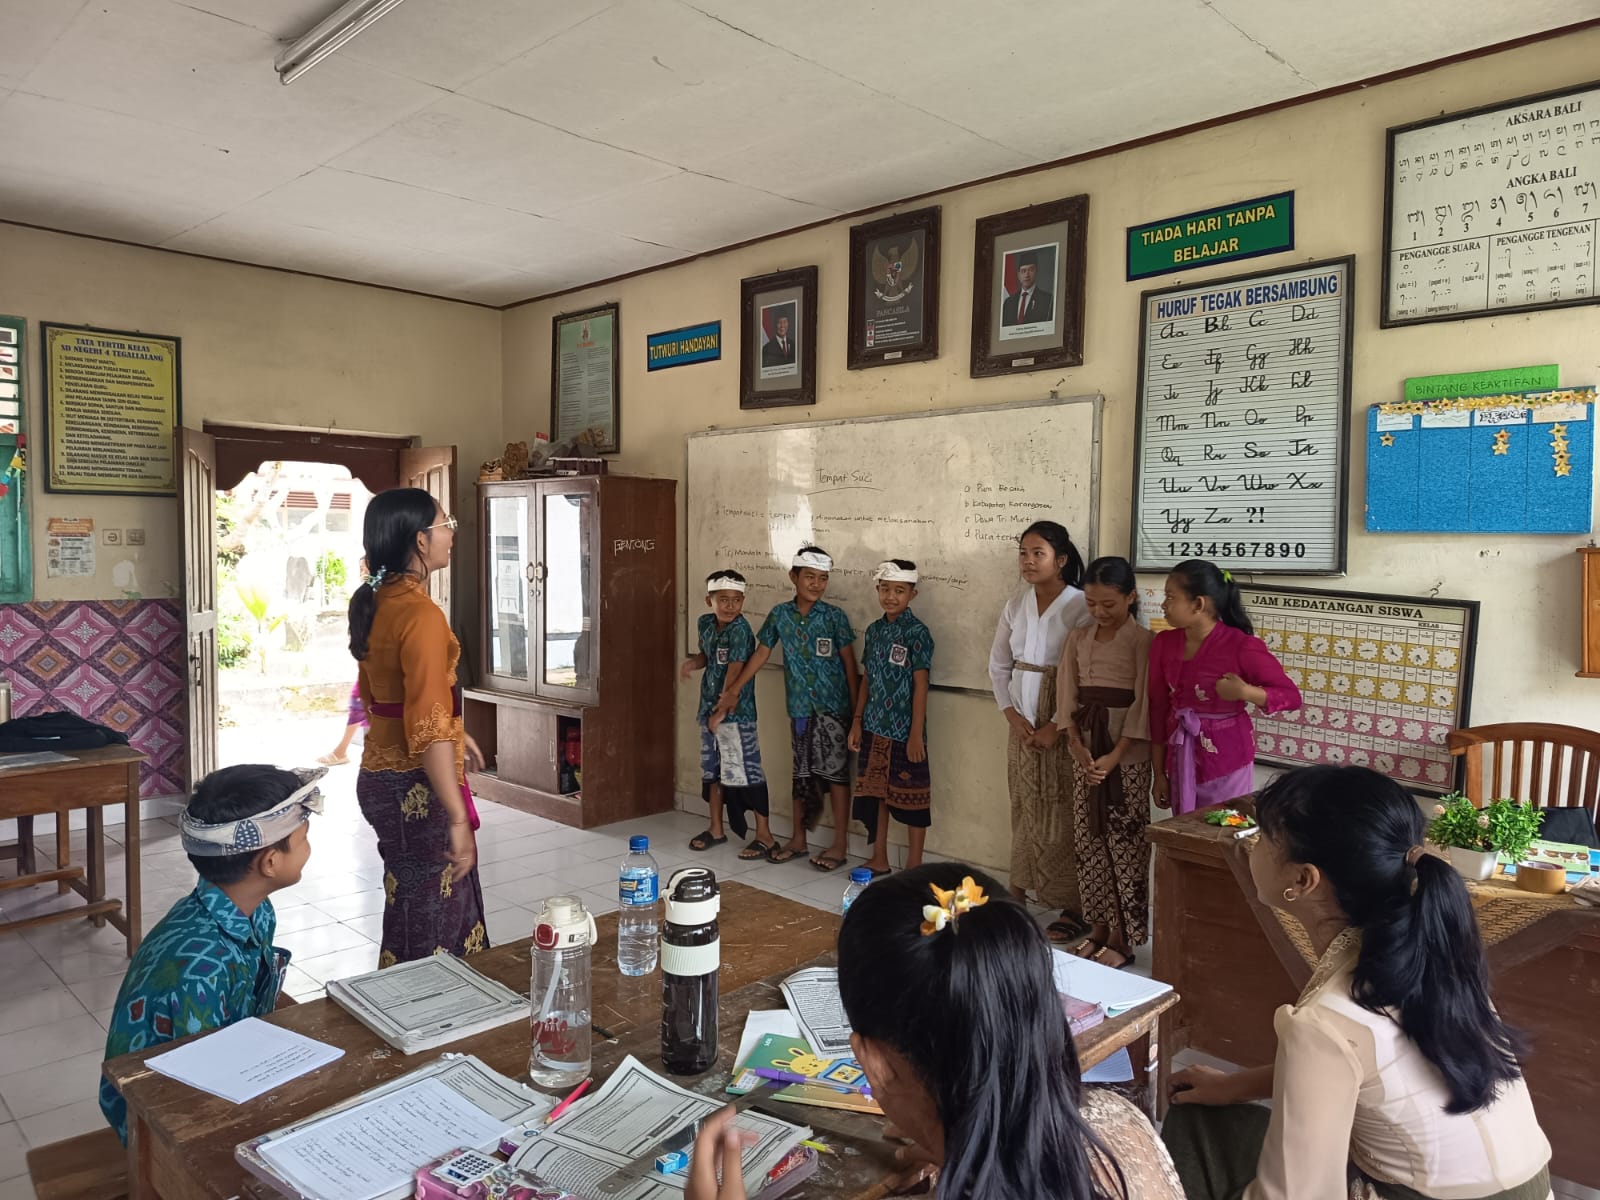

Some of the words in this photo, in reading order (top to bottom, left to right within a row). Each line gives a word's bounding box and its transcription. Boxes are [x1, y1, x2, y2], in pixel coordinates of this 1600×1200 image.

[1505, 109, 1552, 128] AKSARA
[1553, 101, 1582, 118] BALI
[1506, 170, 1547, 189] ANGKA
[1549, 166, 1577, 182] BALI
[1527, 212, 1534, 222] 5
[1553, 208, 1559, 218] 6
[1582, 203, 1588, 213] 7
[1142, 225, 1183, 246] TIADA
[1186, 215, 1222, 238] HARI
[1226, 204, 1276, 228] TANPA
[1438, 227, 1444, 237] 2
[1463, 223, 1469, 233] 3
[1495, 218, 1502, 227] 4
[1412, 231, 1417, 241] 1
[1496, 228, 1545, 246] PENGANGGE
[1546, 224, 1591, 240] TENGENAN
[1173, 237, 1239, 263] BELAJAR
[1399, 246, 1451, 261] PENGANGGE
[1451, 241, 1481, 255] SUARA
[1157, 298, 1198, 319] HURUF
[1201, 290, 1242, 313] TEGAK
[1245, 274, 1338, 306] BERSAMBUNG
[1160, 322, 1189, 339] Aa
[1204, 315, 1232, 334] Bb
[1248, 310, 1269, 328] Cc
[1291, 304, 1320, 322] Dd
[76, 338, 94, 346] TATA
[128, 344, 150, 352] KELAS
[649, 342, 679, 361] TUTWURI
[680, 333, 718, 355] HANDAYANI
[1415, 382, 1468, 395] BINTANG
[1472, 376, 1542, 392] KEAKTIFAN
[1156, 414, 1189, 431] Mm
[1200, 411, 1230, 429] Nn
[1244, 408, 1268, 425] Oo
[816, 467, 849, 486] Tempat
[851, 469, 873, 483] Suci
[1252, 595, 1279, 607] JAM
[1282, 598, 1375, 616] KEDATANGAN
[1378, 605, 1424, 619] SISWA
